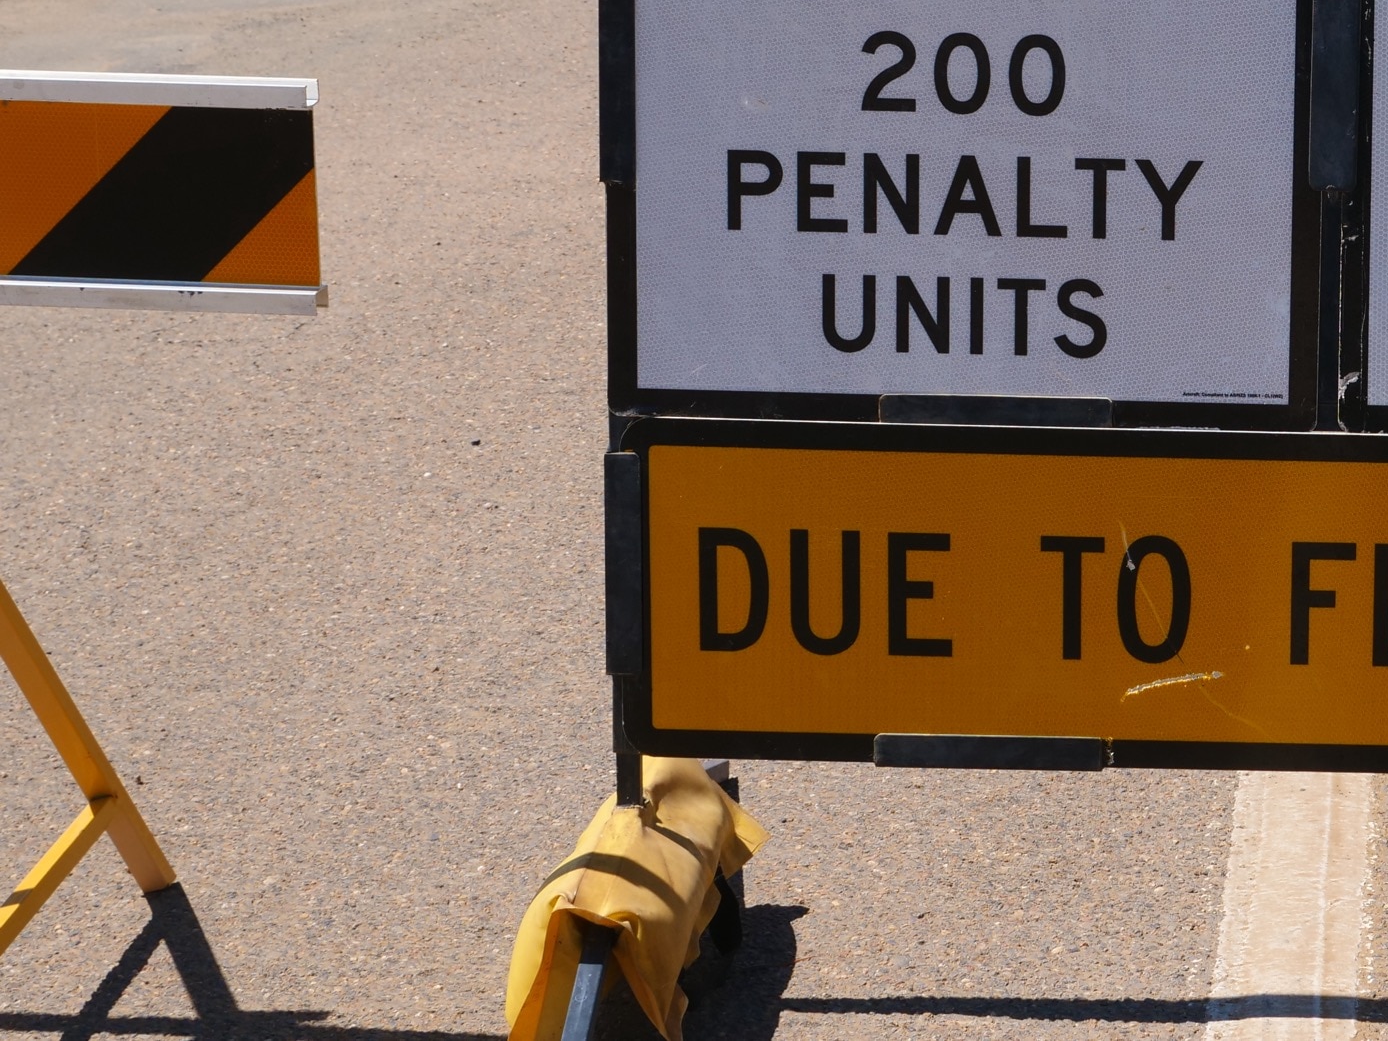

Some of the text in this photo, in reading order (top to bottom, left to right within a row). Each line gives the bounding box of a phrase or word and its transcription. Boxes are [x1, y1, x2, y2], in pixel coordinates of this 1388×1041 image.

[860, 30, 1067, 117] 200
[726, 149, 1204, 241] PENALTY
[821, 273, 1108, 359] UNITS
[696, 526, 954, 659] DUE
[1040, 534, 1193, 665] TO
